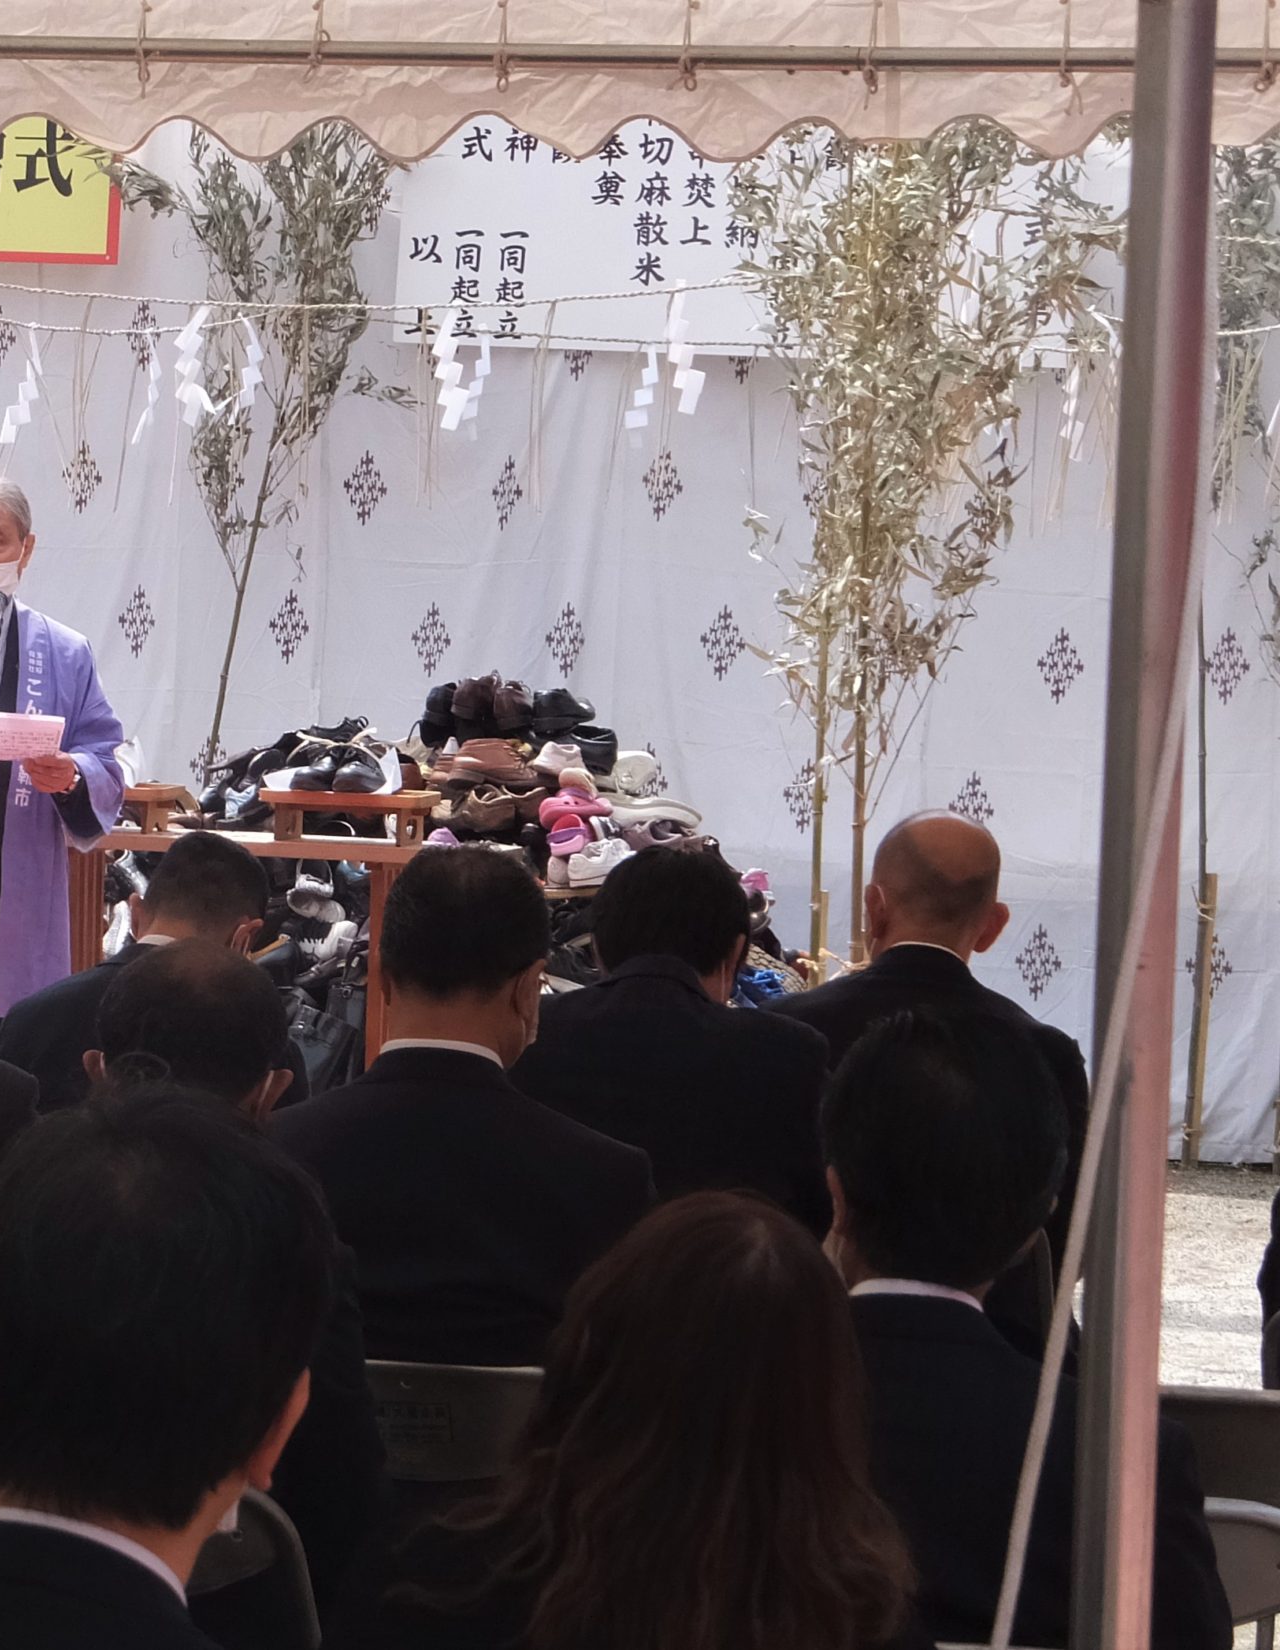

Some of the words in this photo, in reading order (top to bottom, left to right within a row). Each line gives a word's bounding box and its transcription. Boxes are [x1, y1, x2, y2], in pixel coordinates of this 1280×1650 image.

[462, 126, 493, 162] 式
[630, 118, 674, 286] 切麻散米
[680, 151, 716, 246] 焚上
[450, 229, 485, 338] 一同起立
[493, 231, 530, 339] 一同起立
